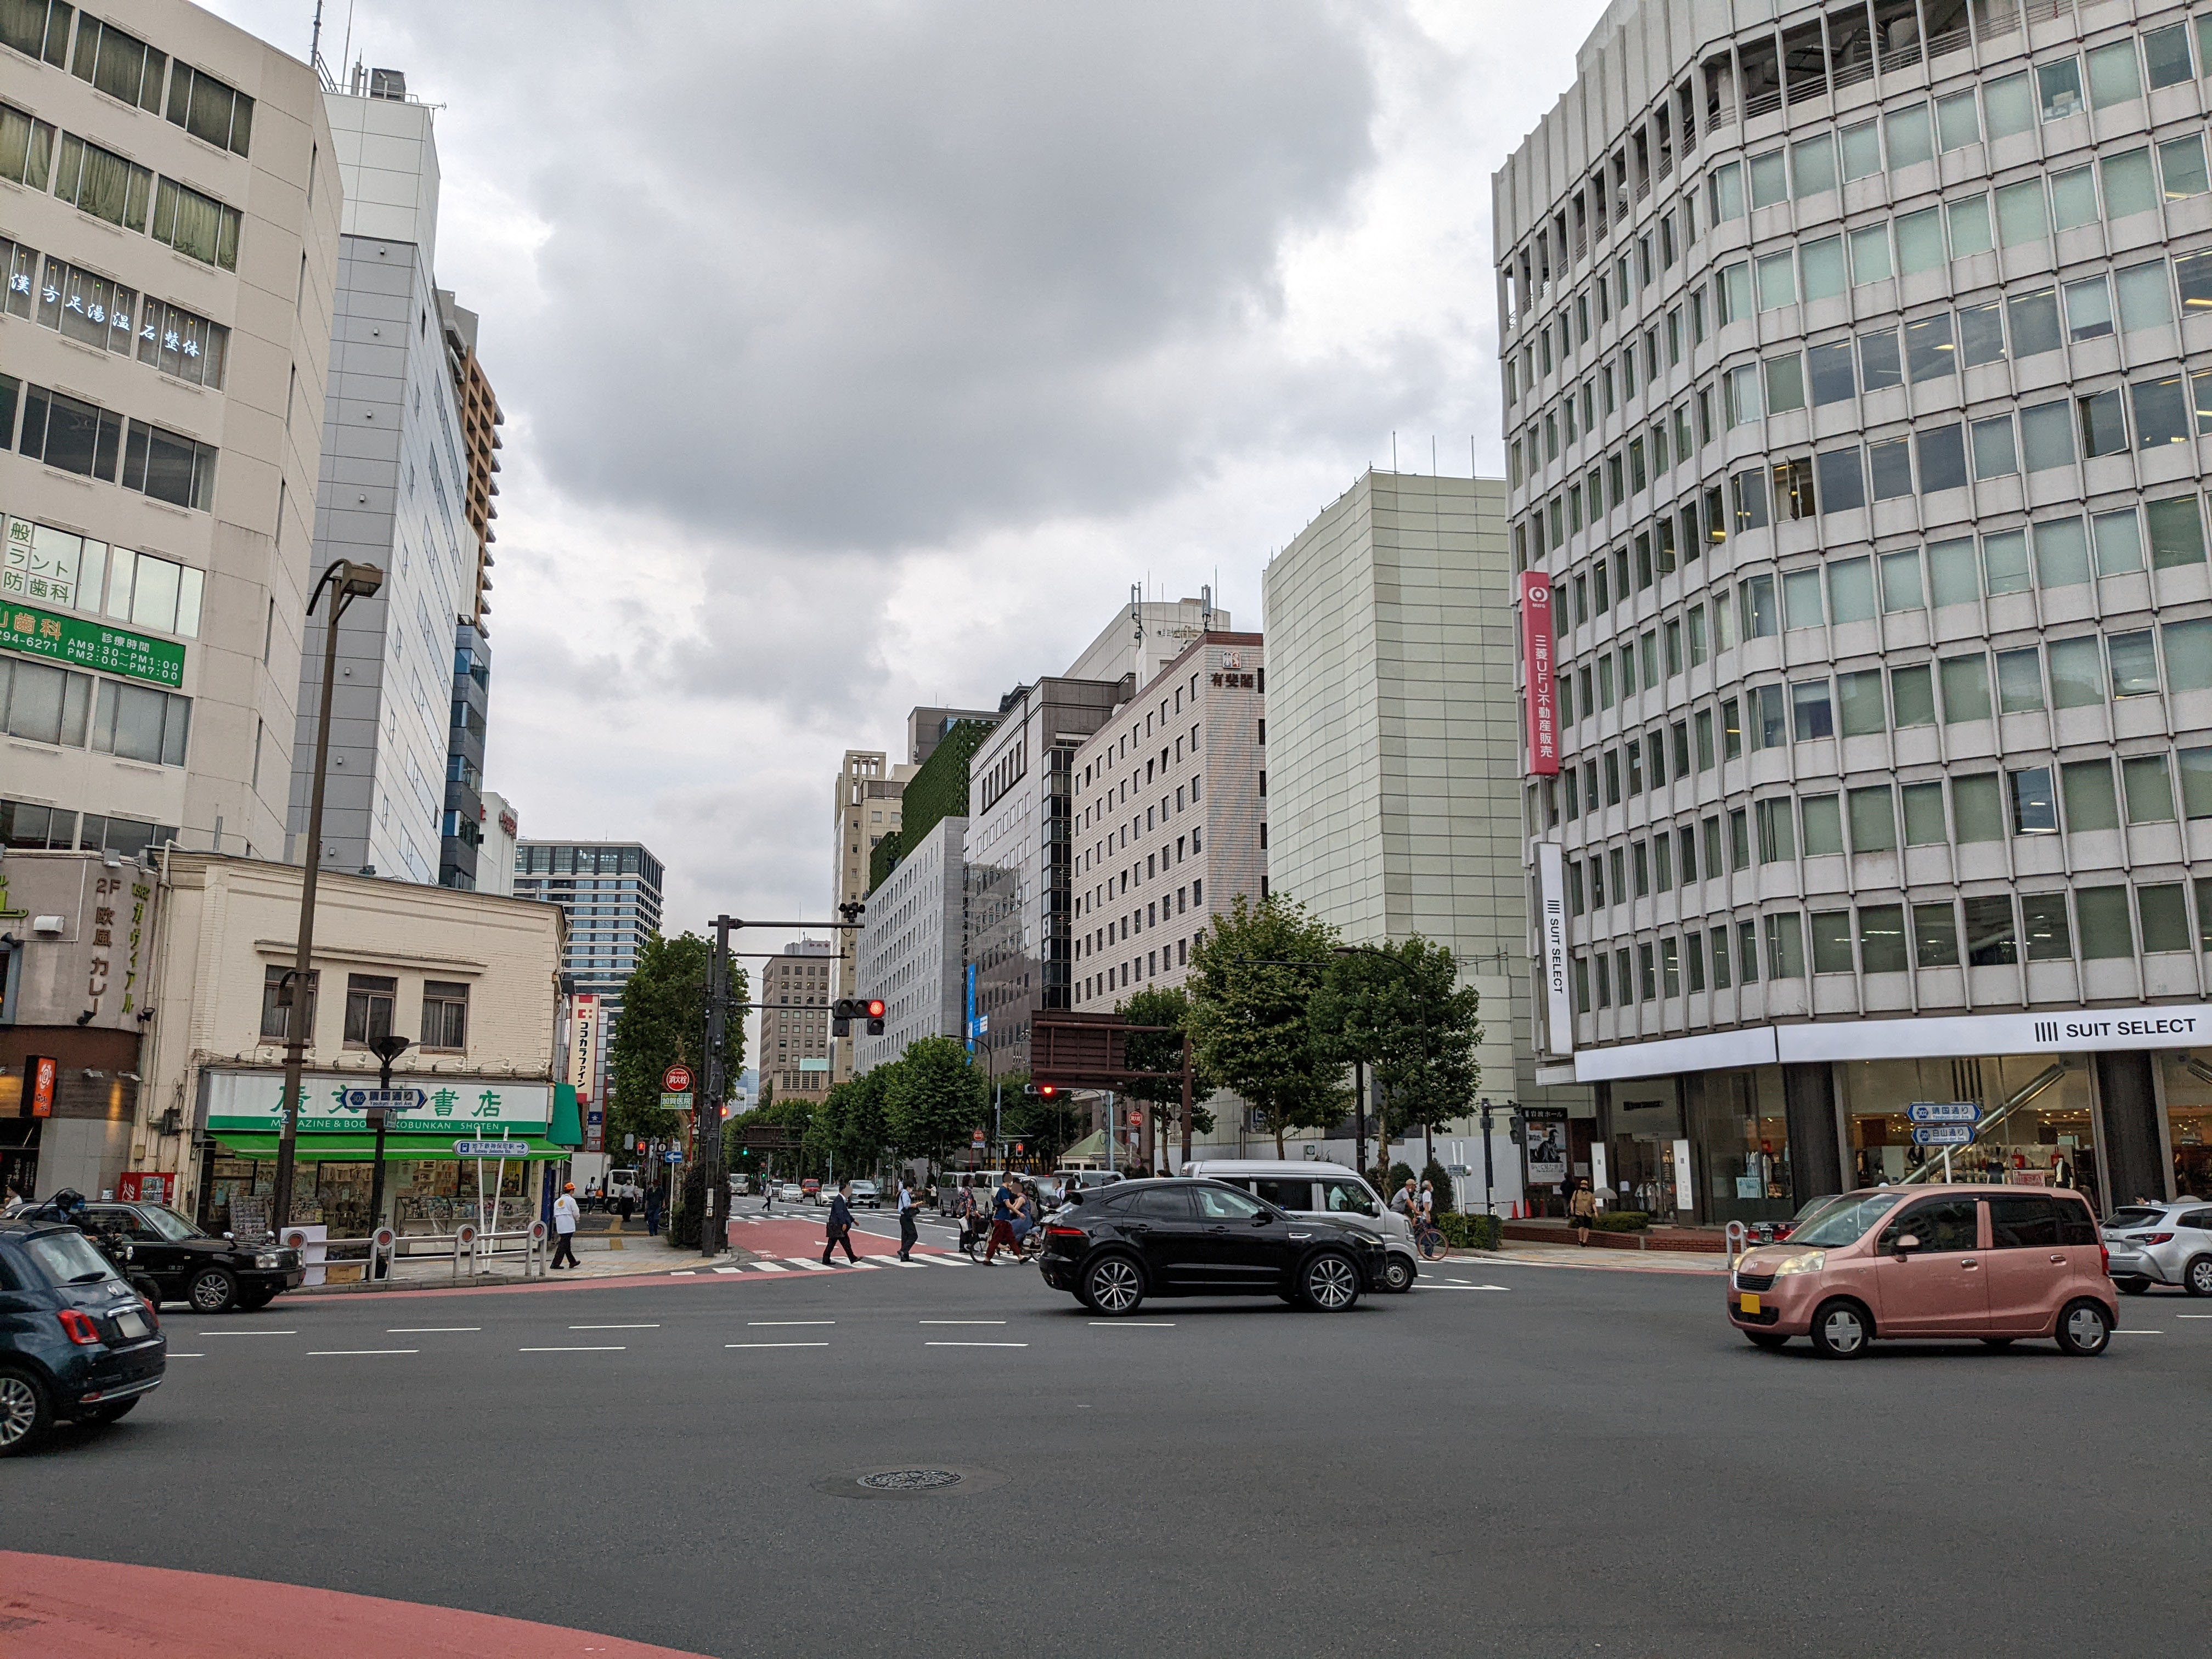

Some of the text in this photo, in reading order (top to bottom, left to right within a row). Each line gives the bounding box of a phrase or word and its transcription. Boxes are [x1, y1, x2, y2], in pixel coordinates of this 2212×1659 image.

[10, 273, 200, 358] 漢方足湯温石整体
[10, 522, 30, 542] 般
[10, 548, 68, 577] ラント
[3, 572, 69, 603] 防歯科
[102, 632, 150, 653] 診療時間
[1210, 672, 1253, 688] 有斐閣
[1535, 634, 1553, 758] 三菱UFJ不動産販売
[97, 878, 121, 894] 2F
[1550, 918, 1562, 994] SUIT SELECT
[2066, 1018, 2196, 1038] SUIT SELECT
[578, 1022, 589, 1087] ココカラファイン
[669, 1075, 687, 1084] 消火栓
[1932, 1106, 1968, 1114] 靖国通り
[1933, 1128, 1963, 1137] 白山通り
